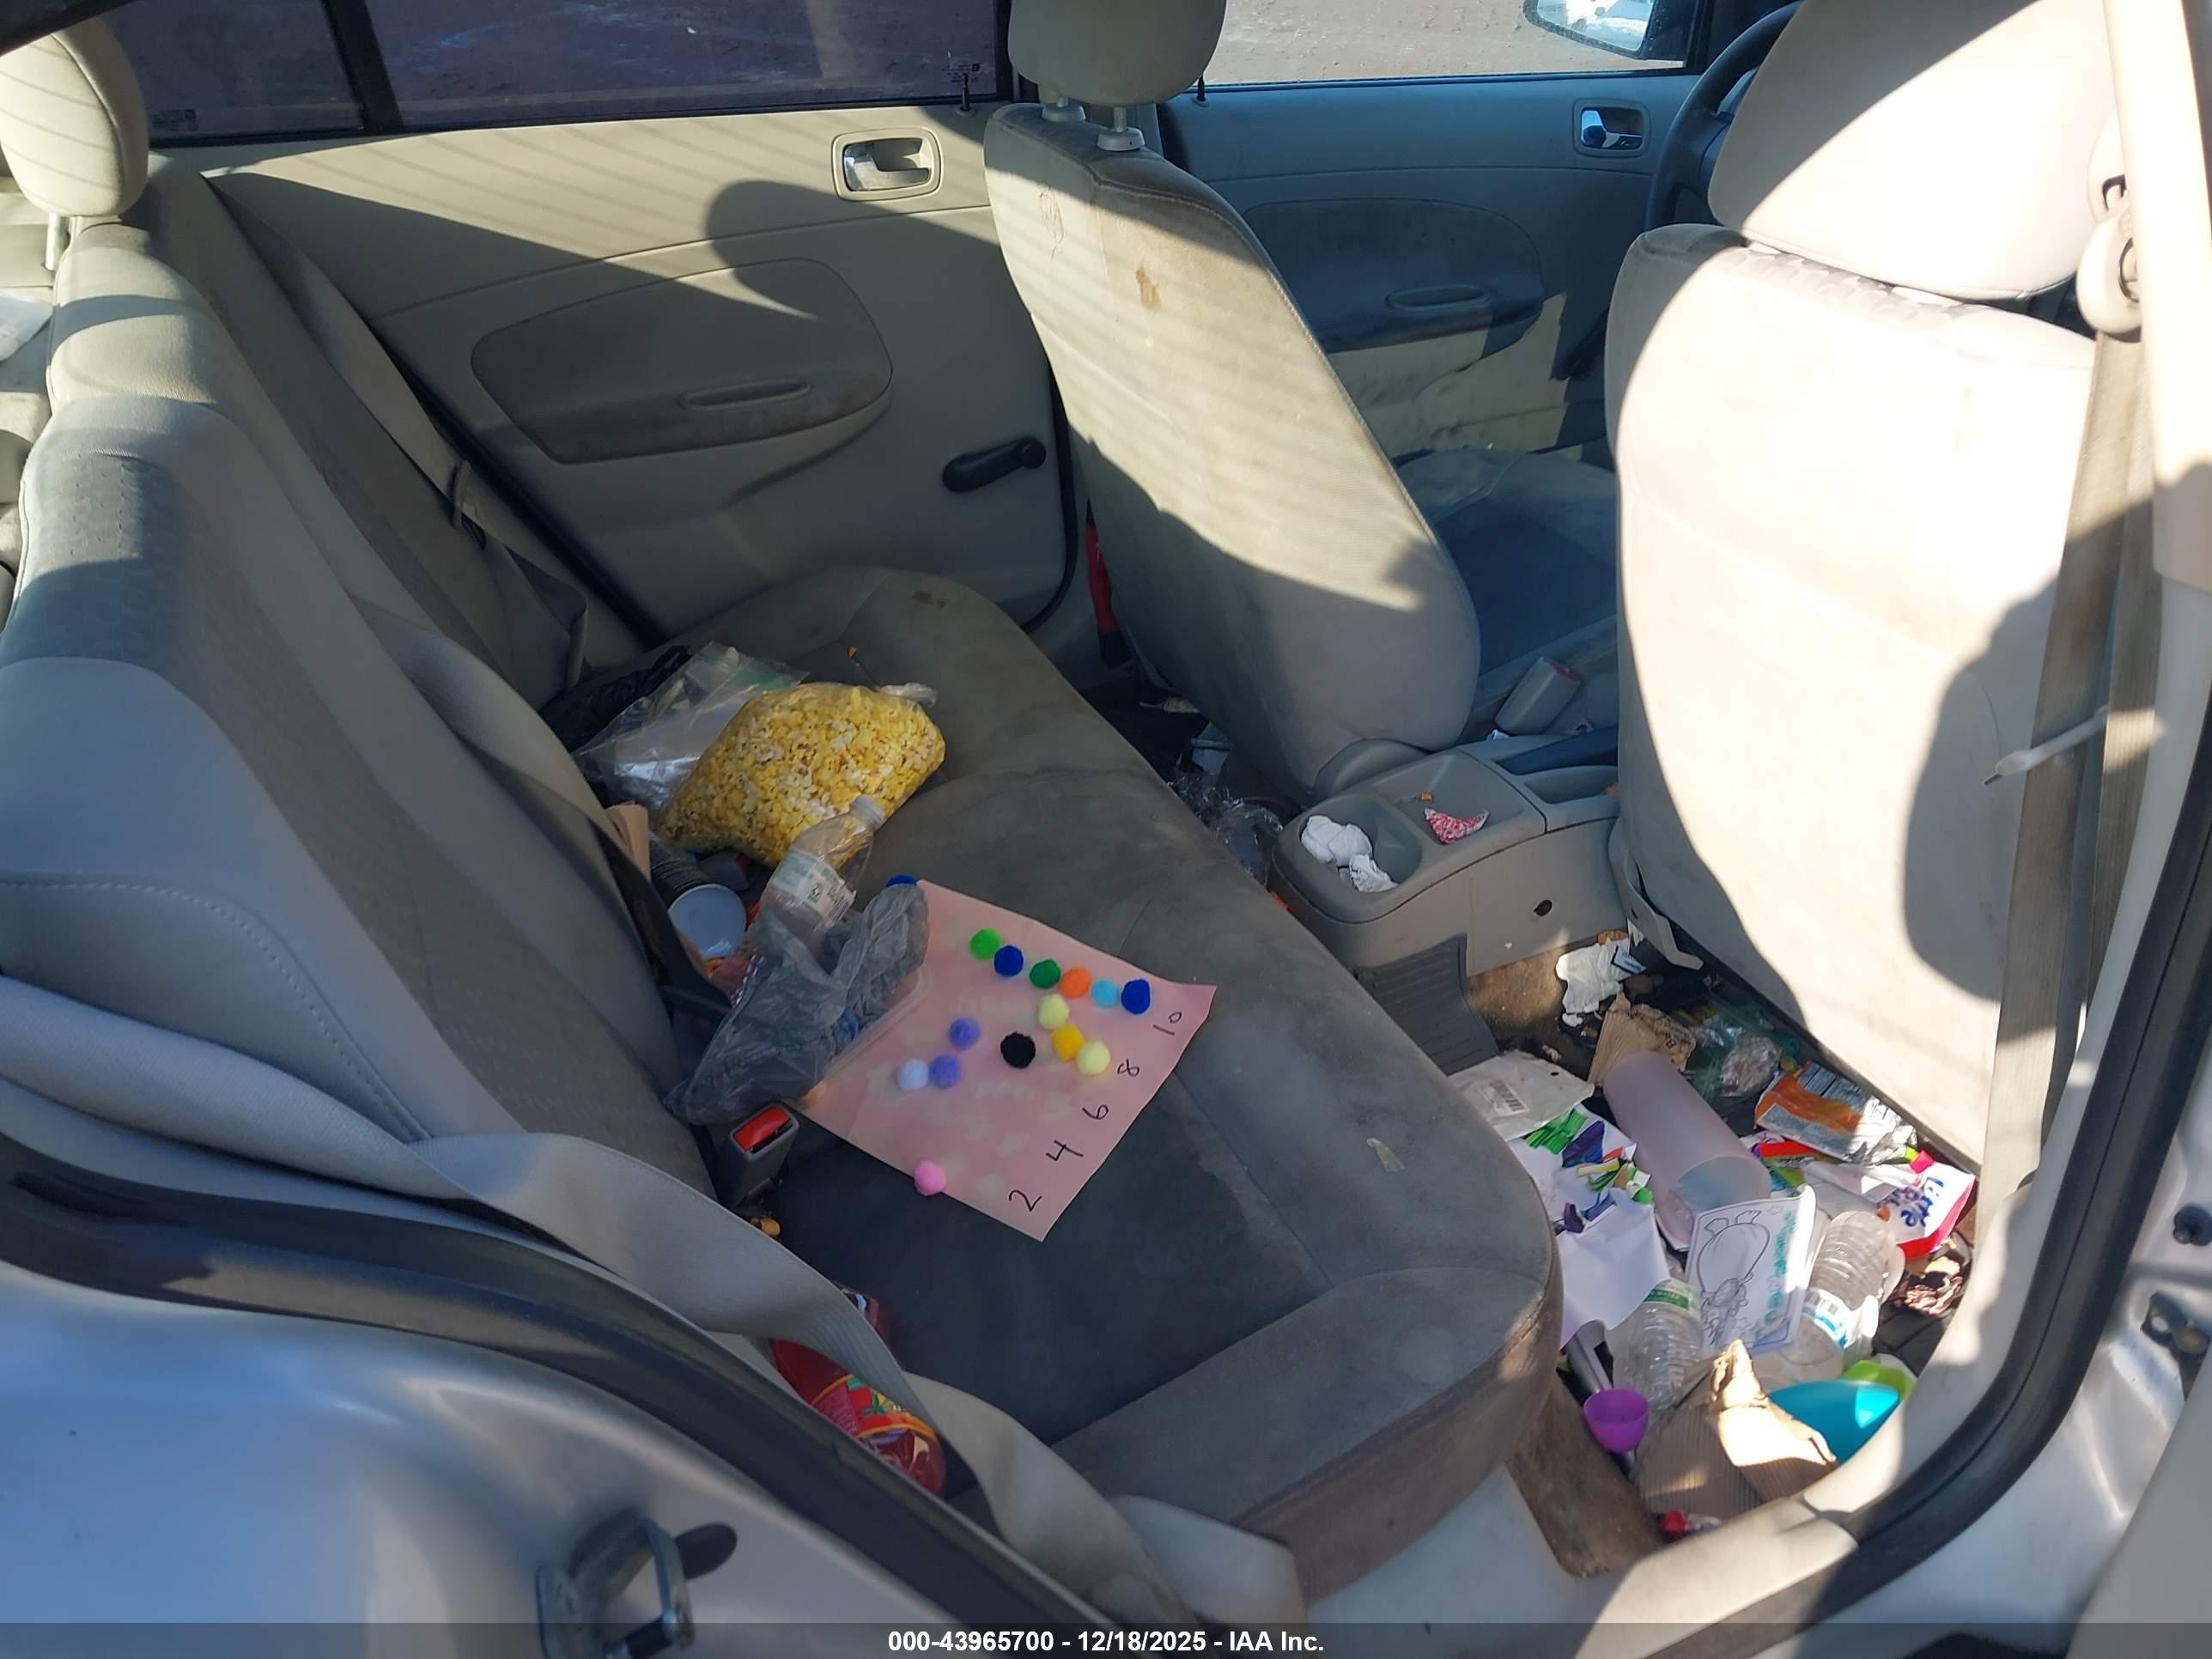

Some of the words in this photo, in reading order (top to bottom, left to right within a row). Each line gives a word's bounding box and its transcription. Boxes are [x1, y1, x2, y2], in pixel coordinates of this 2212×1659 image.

[1008, 1188, 1043, 1212] 2
[1044, 1139, 1085, 1162] 4
[1081, 1103, 1109, 1121] 6
[1116, 1058, 1140, 1078] 8
[1152, 1011, 1182, 1036] 10
